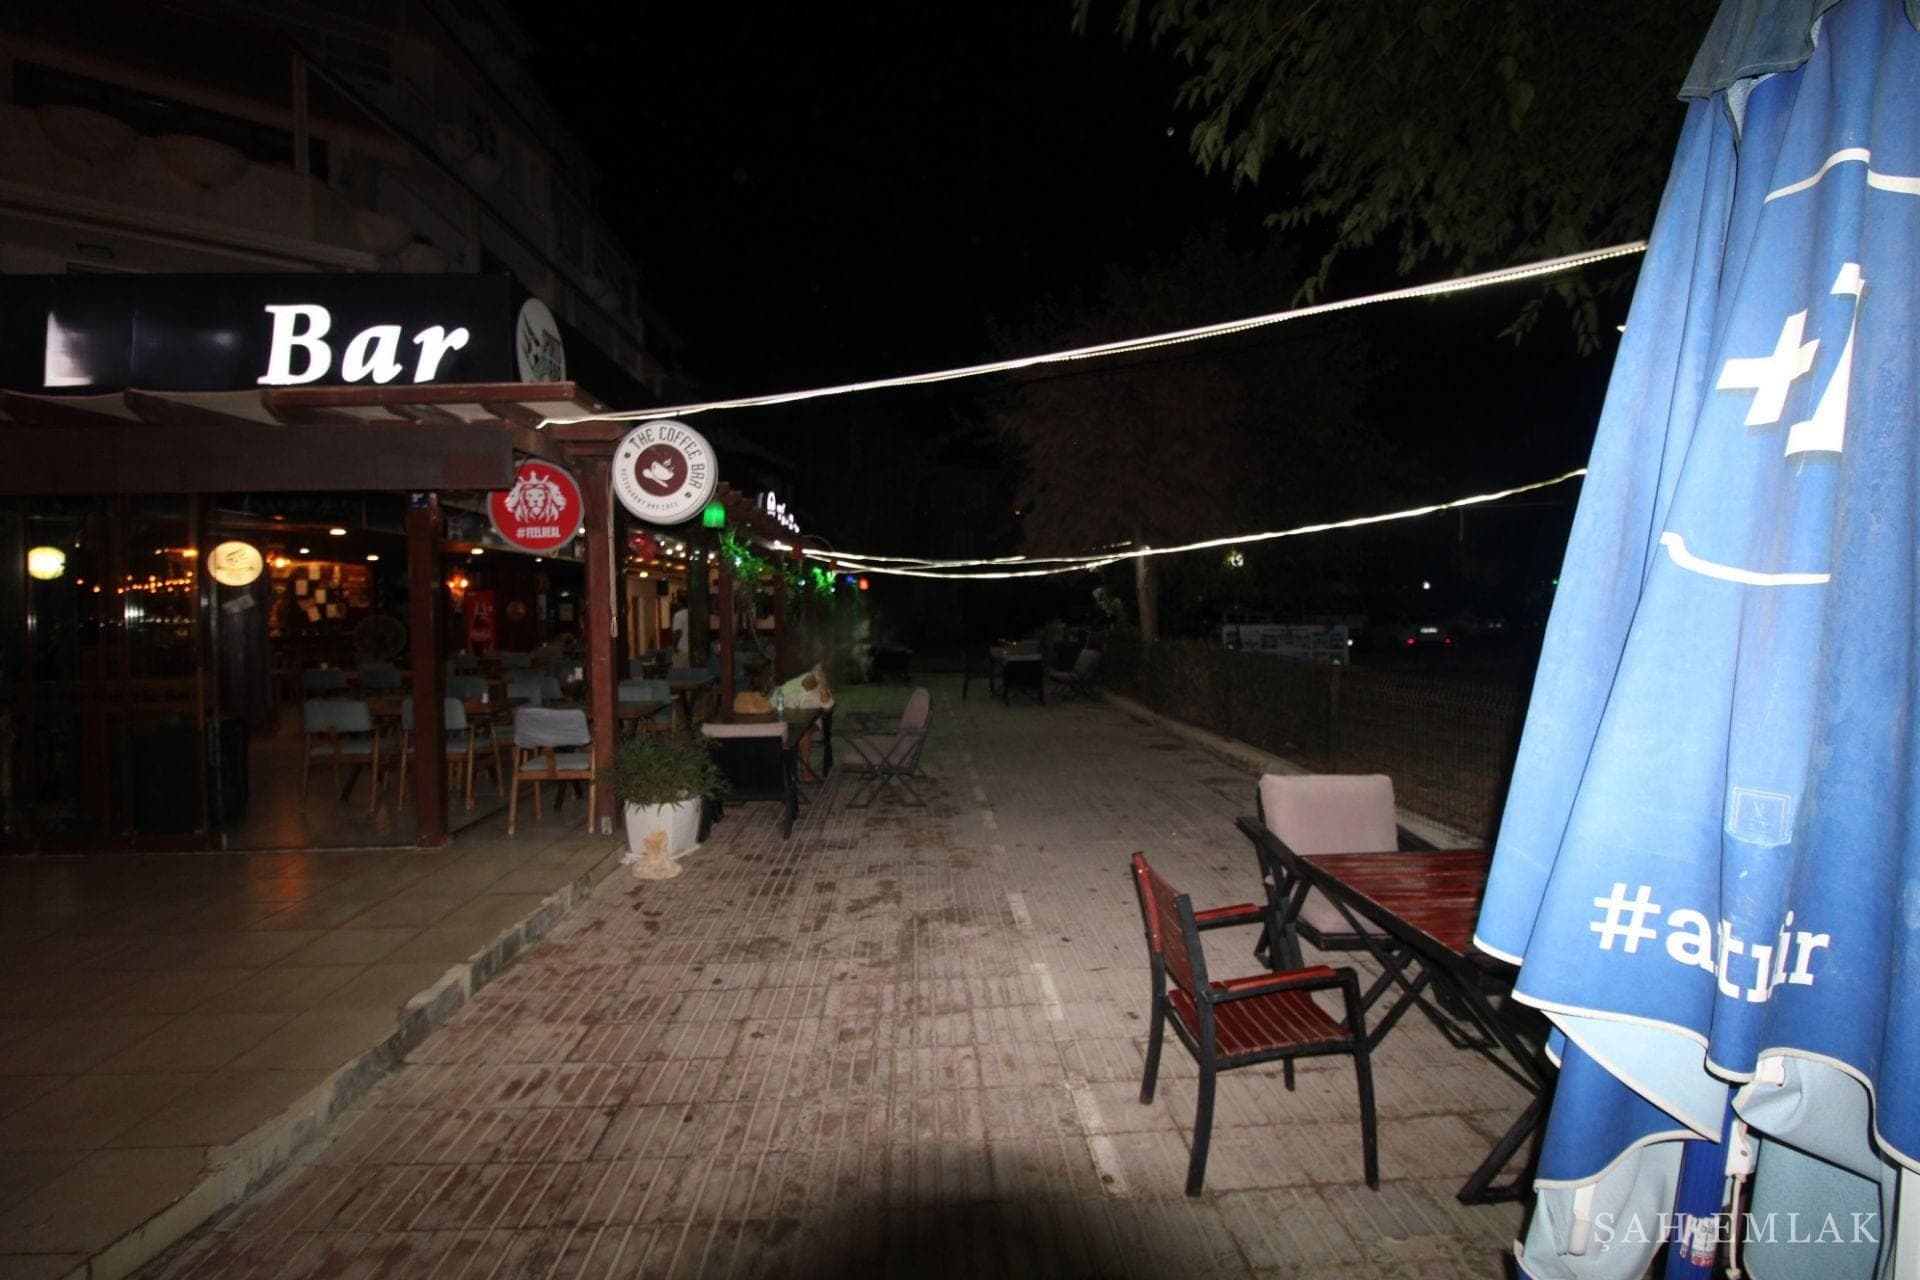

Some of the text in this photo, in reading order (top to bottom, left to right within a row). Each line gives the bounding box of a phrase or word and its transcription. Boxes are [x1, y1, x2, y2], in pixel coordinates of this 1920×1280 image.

[256, 304, 470, 386] Bar
[628, 425, 706, 490] THE COFFEE BAR
